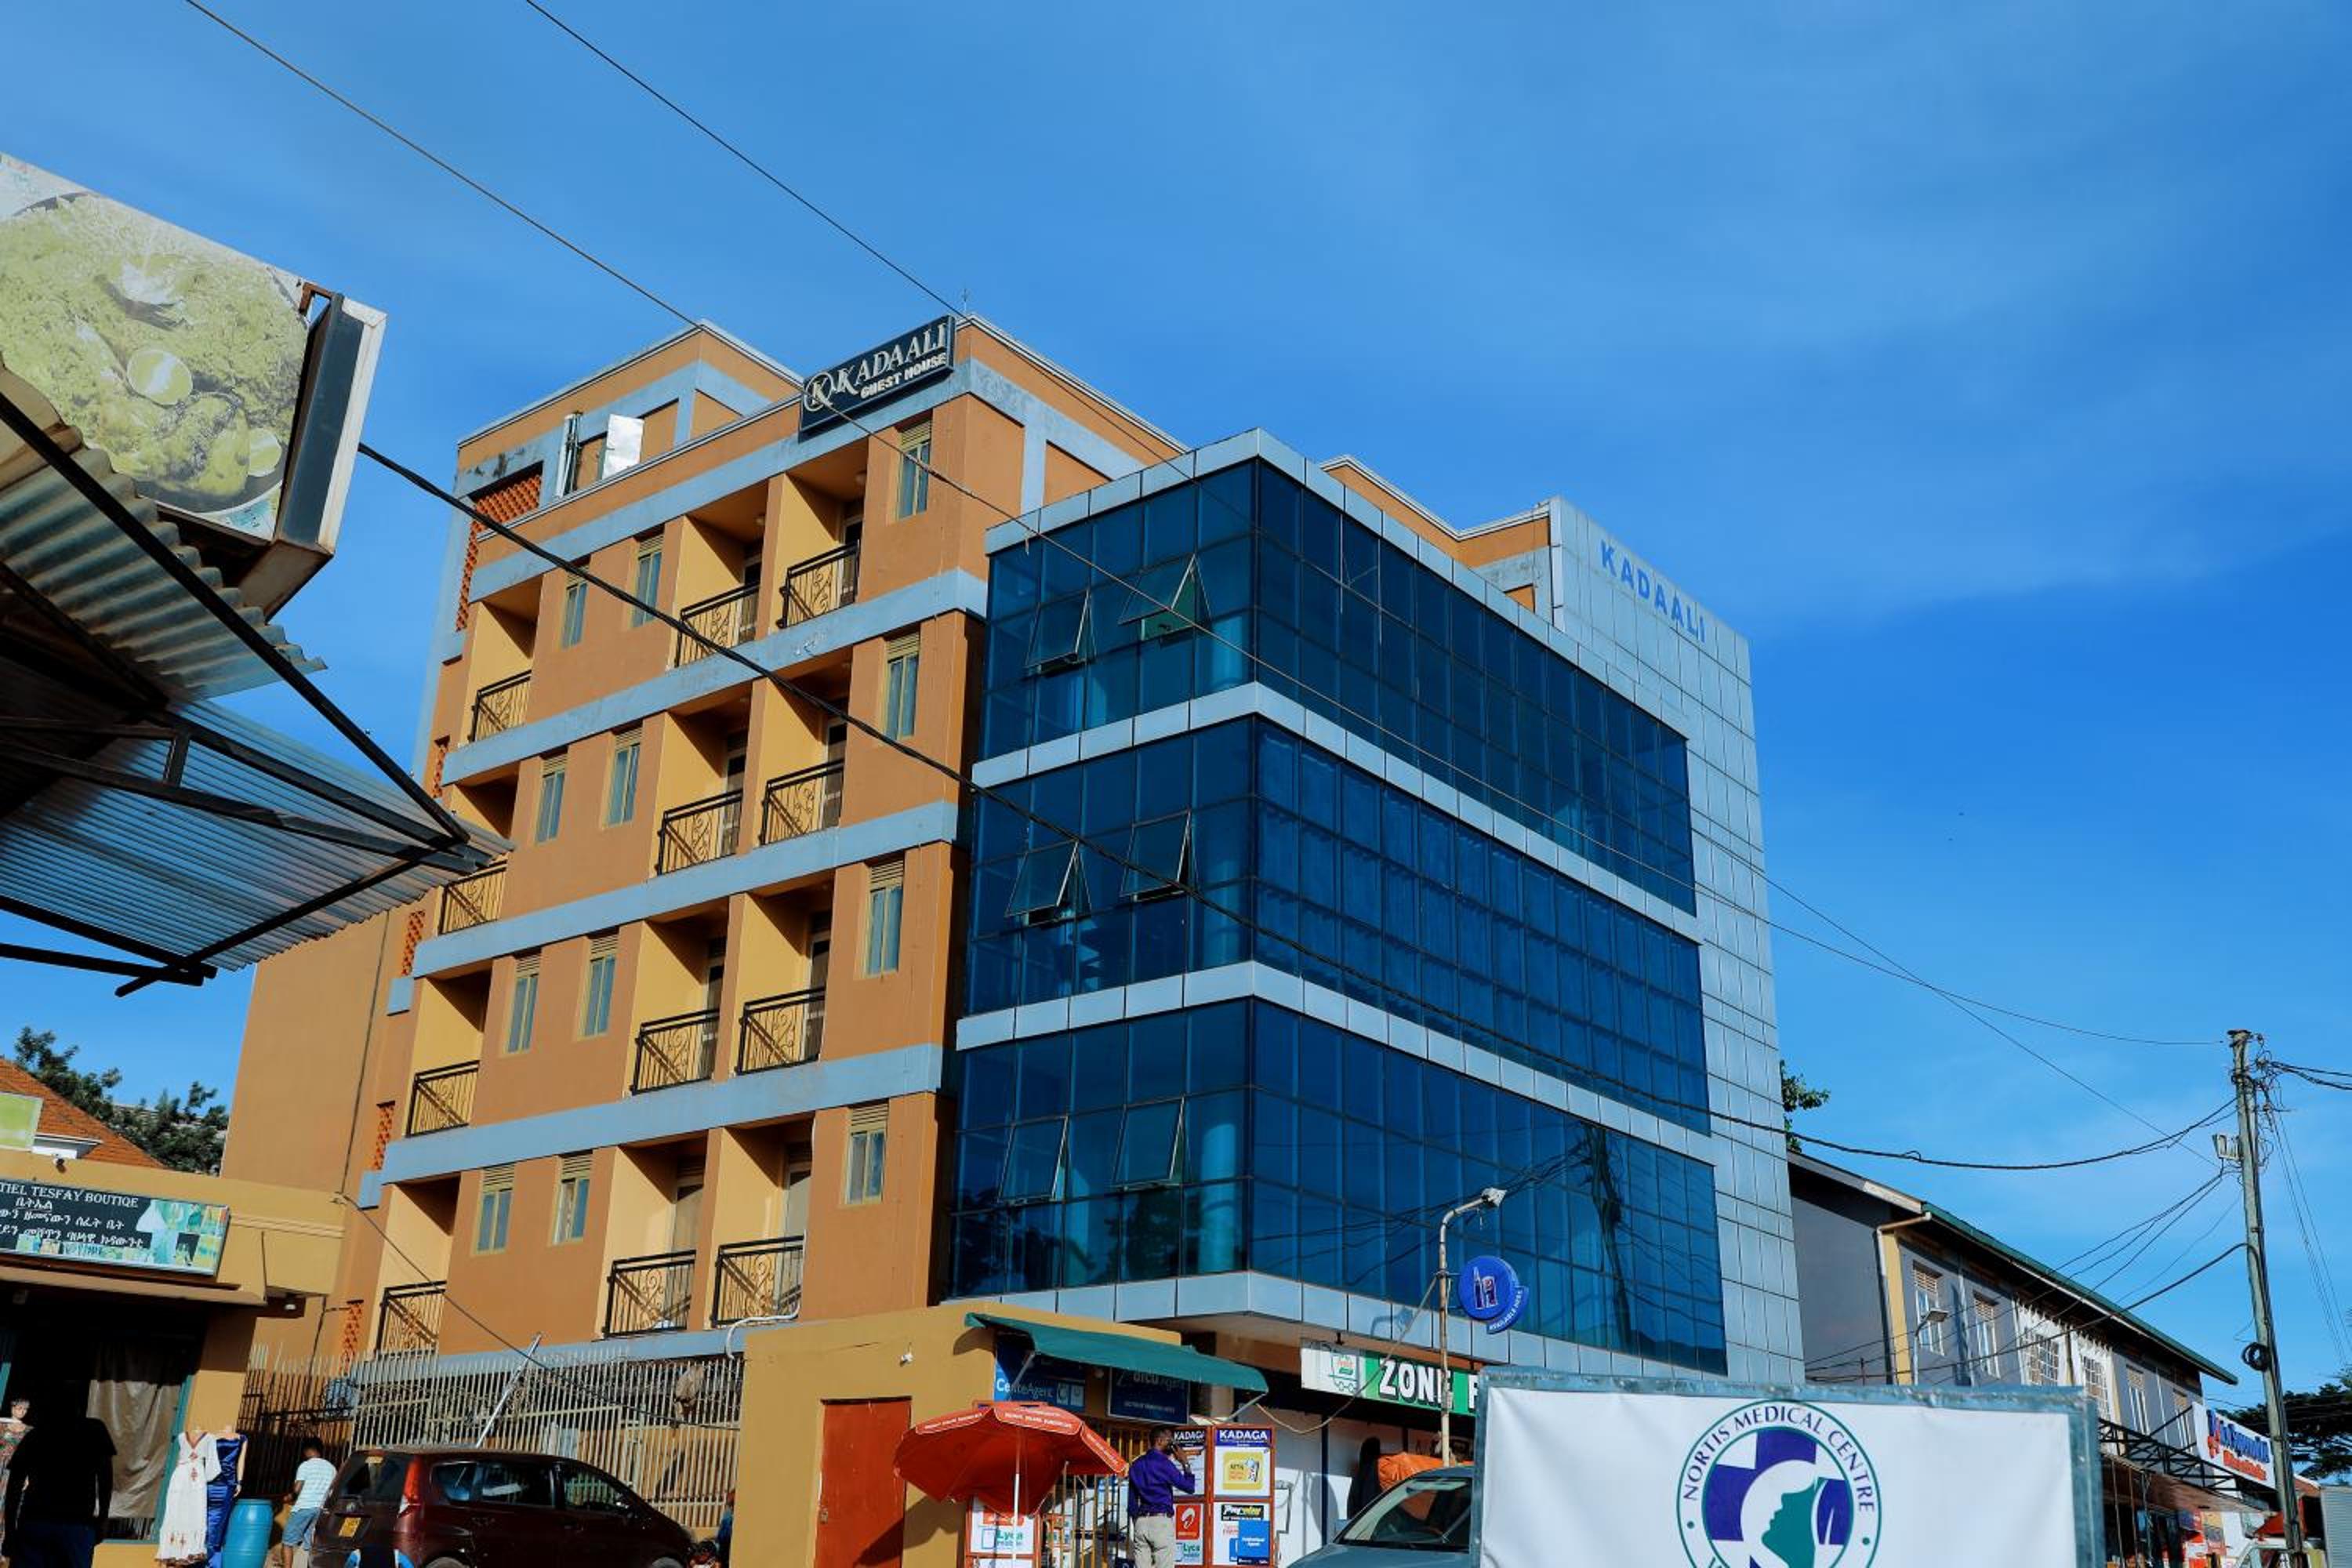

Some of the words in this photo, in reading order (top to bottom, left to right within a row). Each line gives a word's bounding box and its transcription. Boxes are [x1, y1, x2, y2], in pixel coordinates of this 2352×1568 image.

[835, 322, 947, 395] KADAALI
[860, 372, 902, 399] GUEST
[904, 352, 946, 380] HOUSE
[1600, 539, 1706, 643] KADAALI
[31, 1186, 85, 1200] TESFAY
[85, 1192, 139, 1207] BOUTIQE
[1219, 1429, 1268, 1441] KADAGA
[1683, 1427, 1730, 1501] NORTIS
[1734, 1406, 1824, 1435] MEDICAL
[1828, 1430, 1875, 1512] CENTRE
[1183, 1543, 1200, 1554] Lyca
